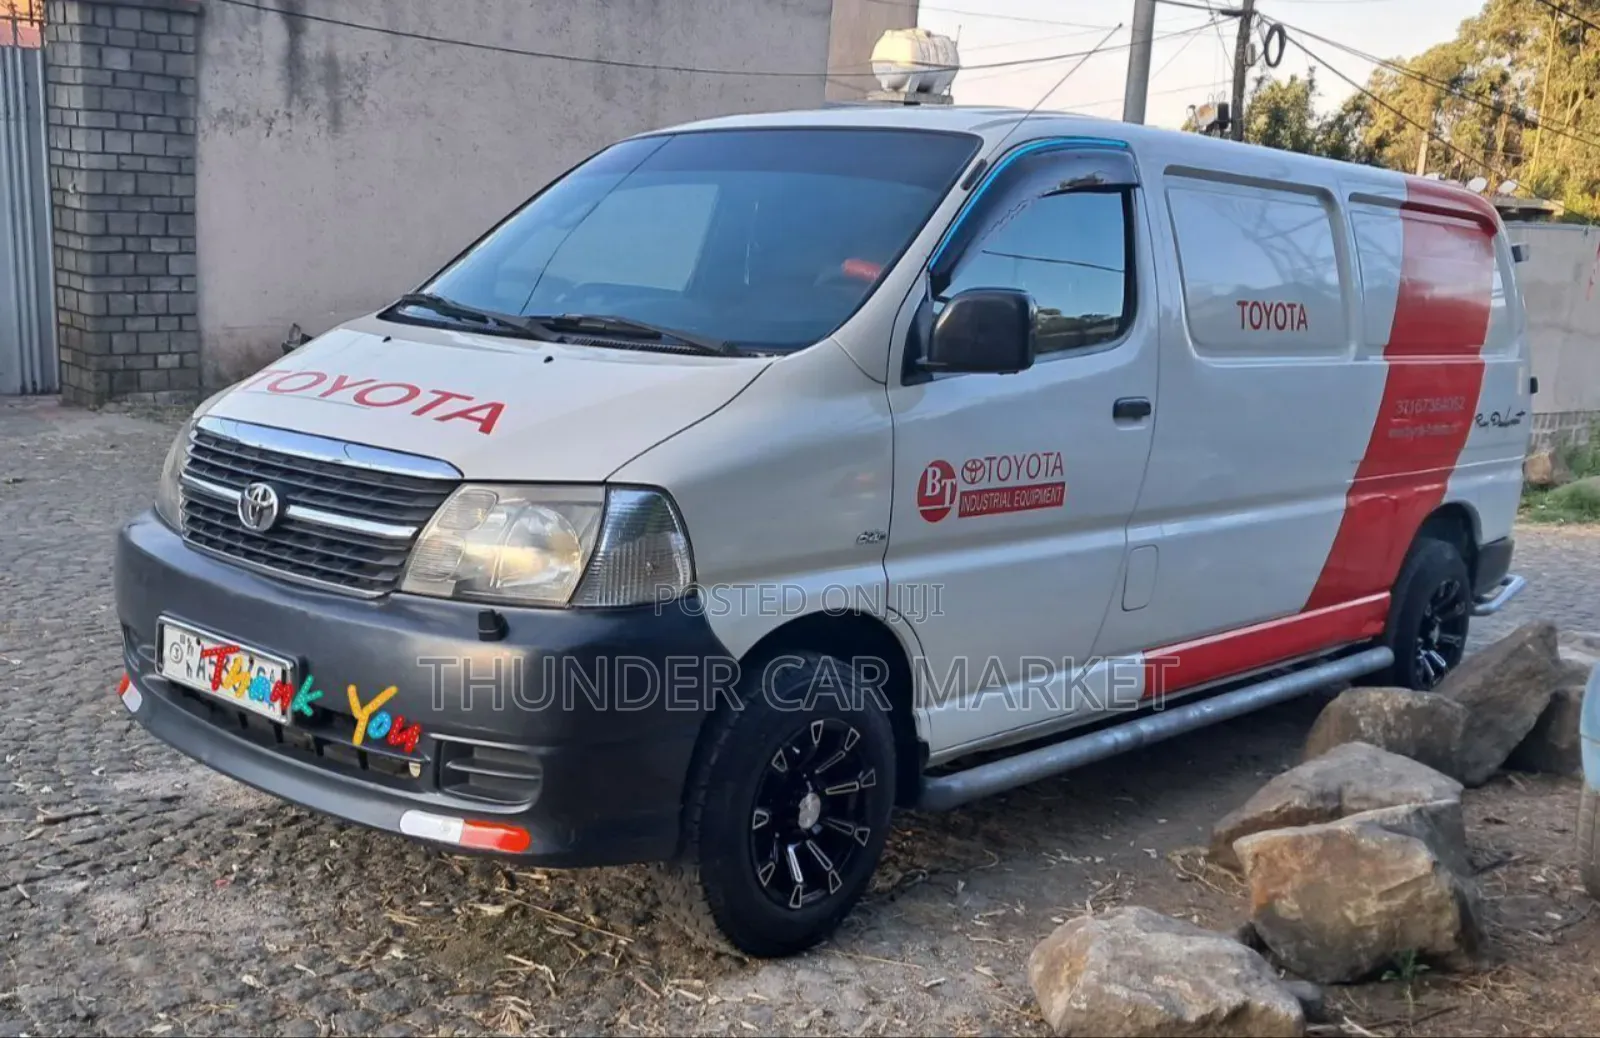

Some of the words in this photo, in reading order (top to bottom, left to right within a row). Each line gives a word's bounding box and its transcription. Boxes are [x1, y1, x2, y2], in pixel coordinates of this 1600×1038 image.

[1236, 300, 1308, 331] TOYOTA
[242, 369, 505, 435] TOYOTA
[985, 452, 1064, 482] TOYOTA
[925, 466, 957, 508] BT
[961, 492, 1012, 513] INDUSTRIAL
[1014, 486, 1063, 507] EQUIPMENT
